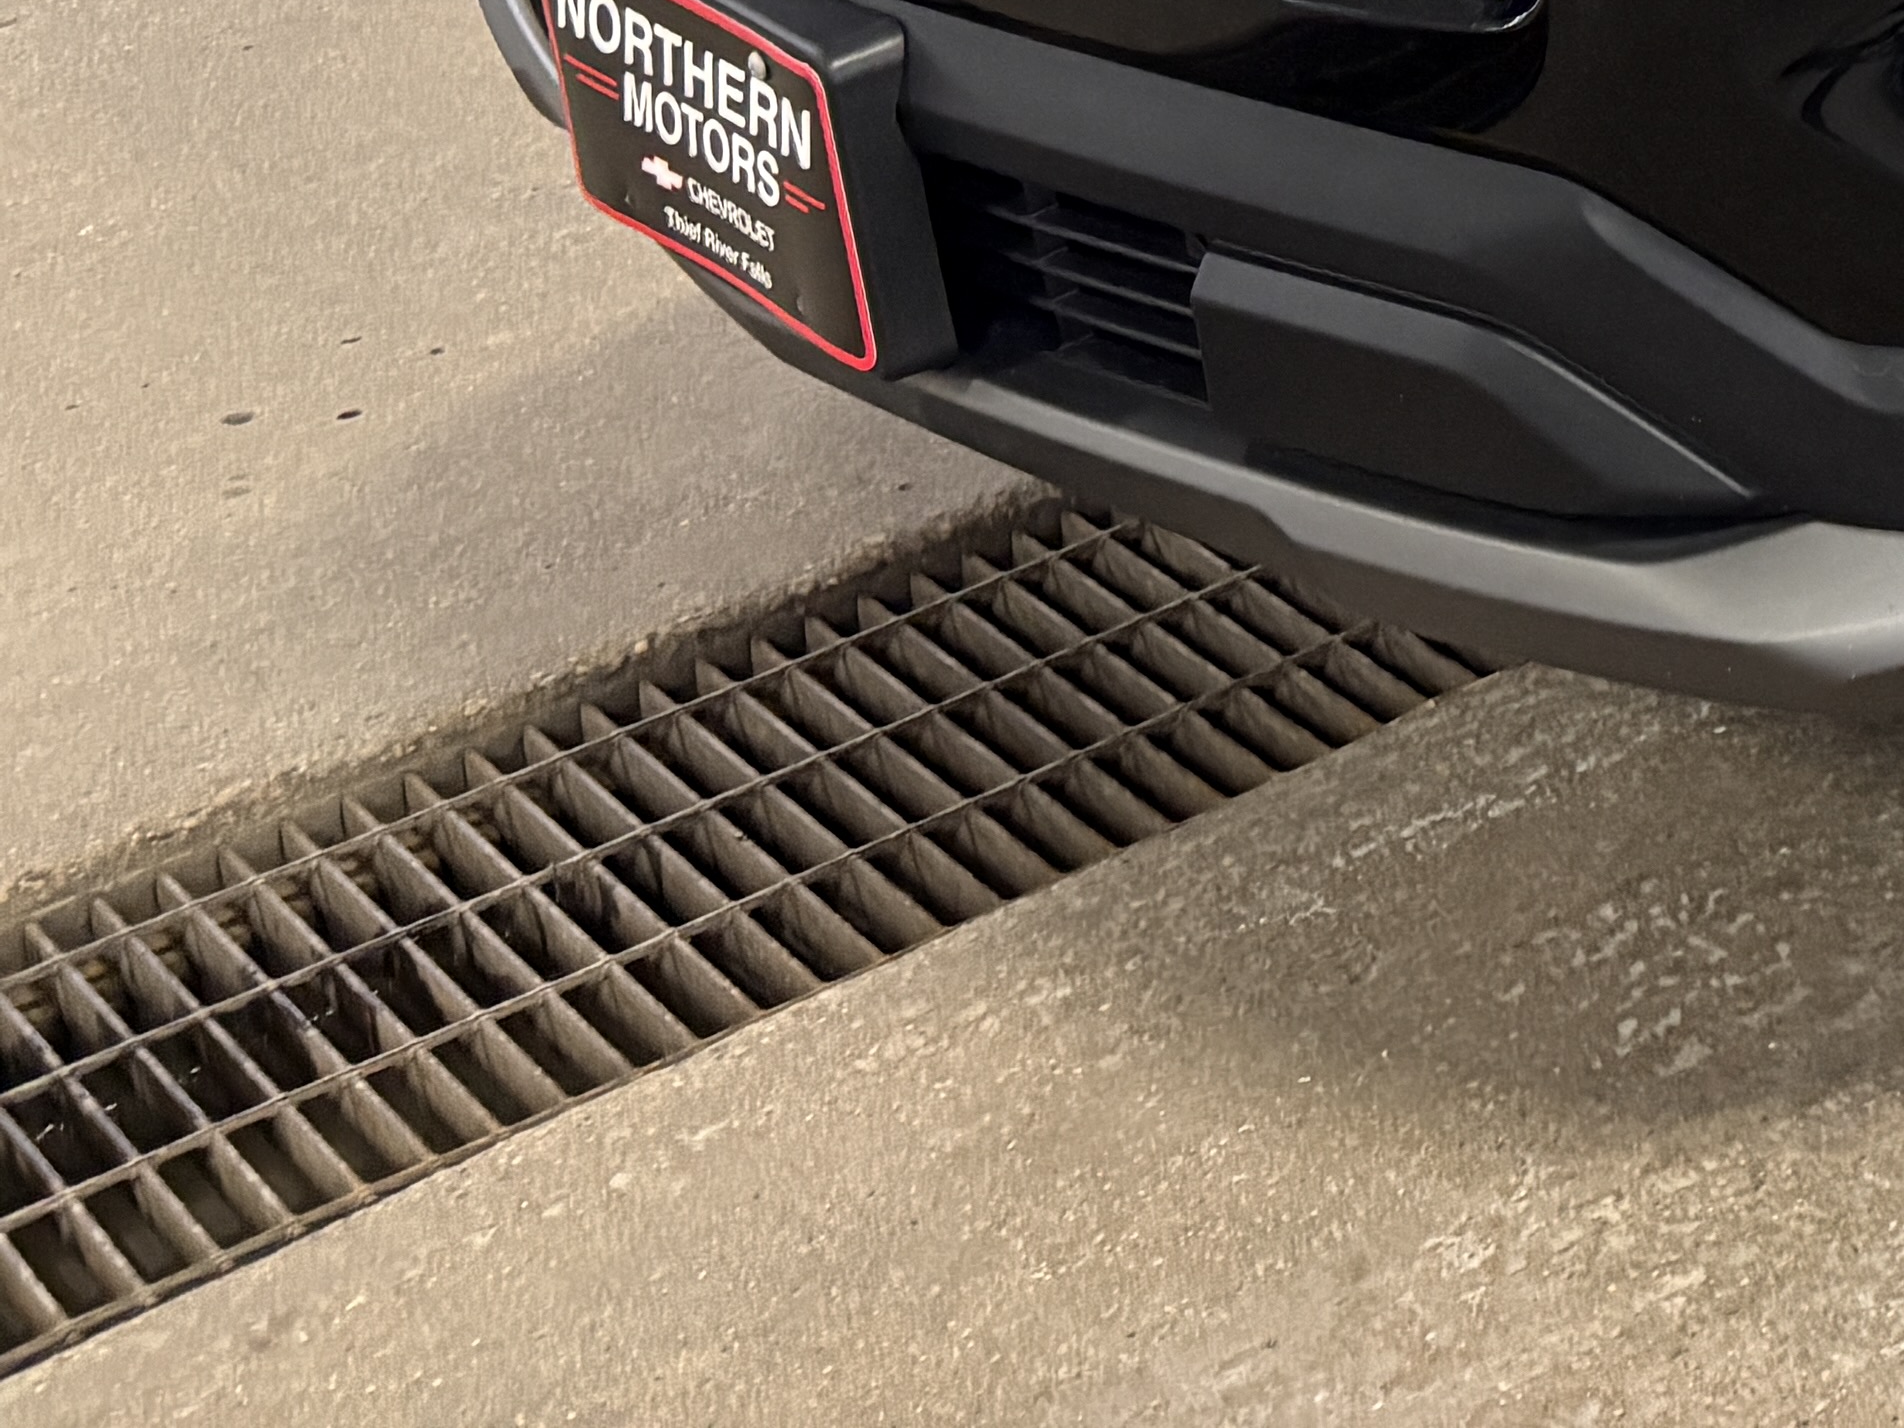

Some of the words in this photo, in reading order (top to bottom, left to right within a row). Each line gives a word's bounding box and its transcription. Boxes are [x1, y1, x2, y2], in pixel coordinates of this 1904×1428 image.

[622, 70, 781, 208] MOTORS
[663, 205, 702, 244] Thief
[704, 227, 740, 266] River
[740, 251, 773, 290] Falls
[686, 176, 776, 252] CHEVROLET
